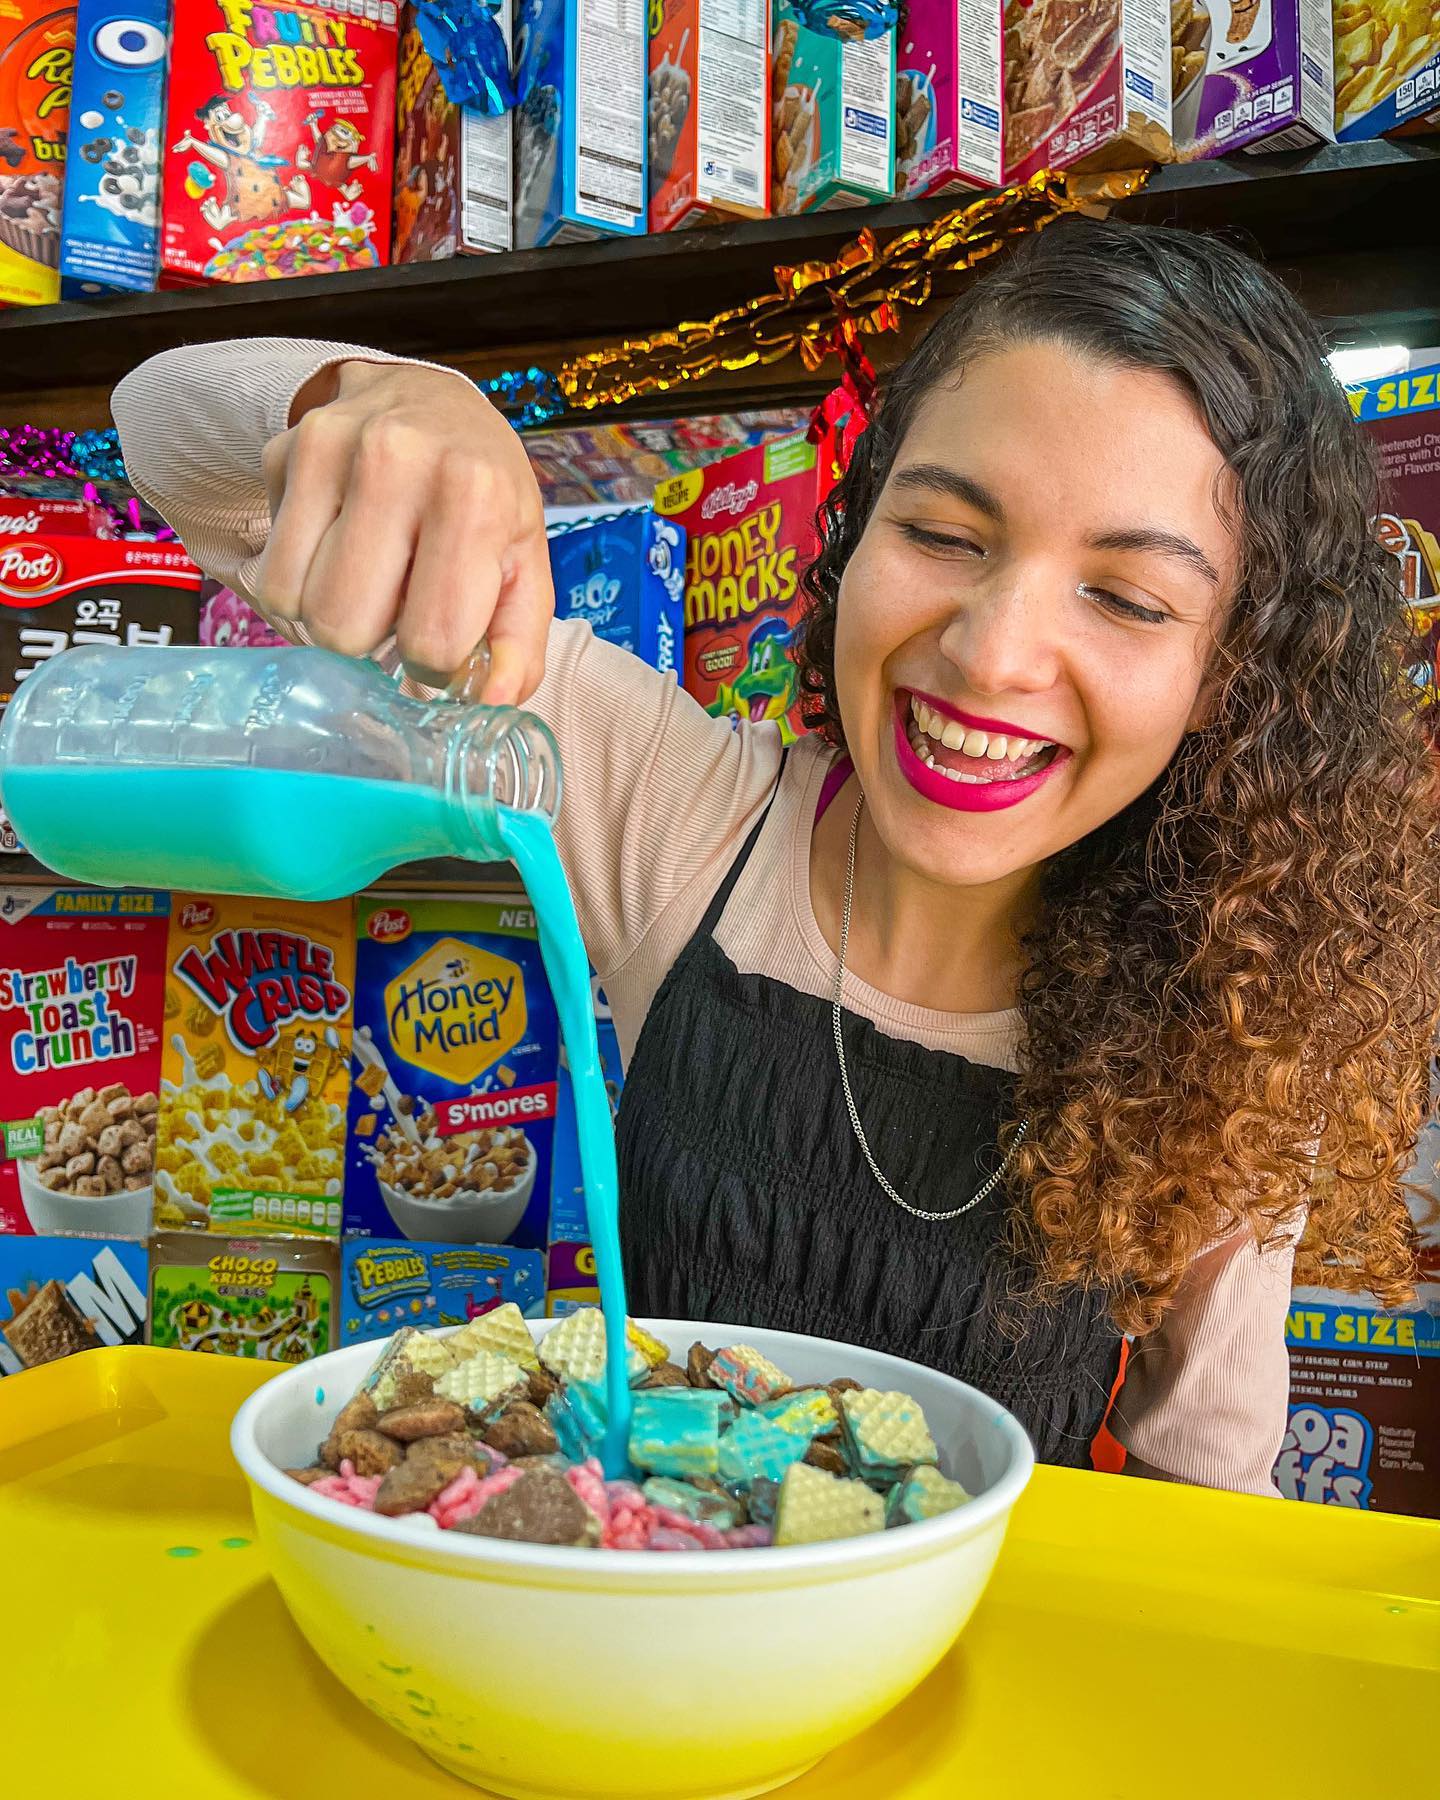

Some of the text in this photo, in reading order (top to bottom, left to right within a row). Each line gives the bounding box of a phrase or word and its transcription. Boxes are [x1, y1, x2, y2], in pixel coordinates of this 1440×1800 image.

[206, 32, 365, 91] PEBBLES
[1376, 372, 1440, 413] SIZ
[701, 480, 758, 519] Kellogg's
[0, 551, 54, 581] Post
[568, 572, 621, 609] BOO
[74, 599, 122, 631] 오곡
[55, 894, 154, 912] FAMILY SIZE
[182, 904, 211, 927] Post
[371, 911, 407, 933] Post
[0, 958, 135, 1006] Strawberry
[178, 932, 332, 1009] WAFFLE
[28, 990, 109, 1034] Toast
[230, 975, 348, 1048] CRISP
[392, 976, 515, 1036] Honey
[13, 1014, 133, 1071] Crunch
[414, 1007, 502, 1053] Maid
[448, 1090, 548, 1127] S'mores
[8, 1127, 37, 1143] REAL
[208, 1255, 278, 1274] CHOCO
[356, 1257, 426, 1290] PEBBLES
[1335, 1314, 1415, 1347] SIZE
[1316, 1371, 1337, 1382] FROM
[1378, 1376, 1414, 1388] SOURCES
[1342, 1358, 1363, 1368] CORN
[1365, 1360, 1390, 1371] SYRUP
[1325, 1386, 1358, 1399] FLAVORS
